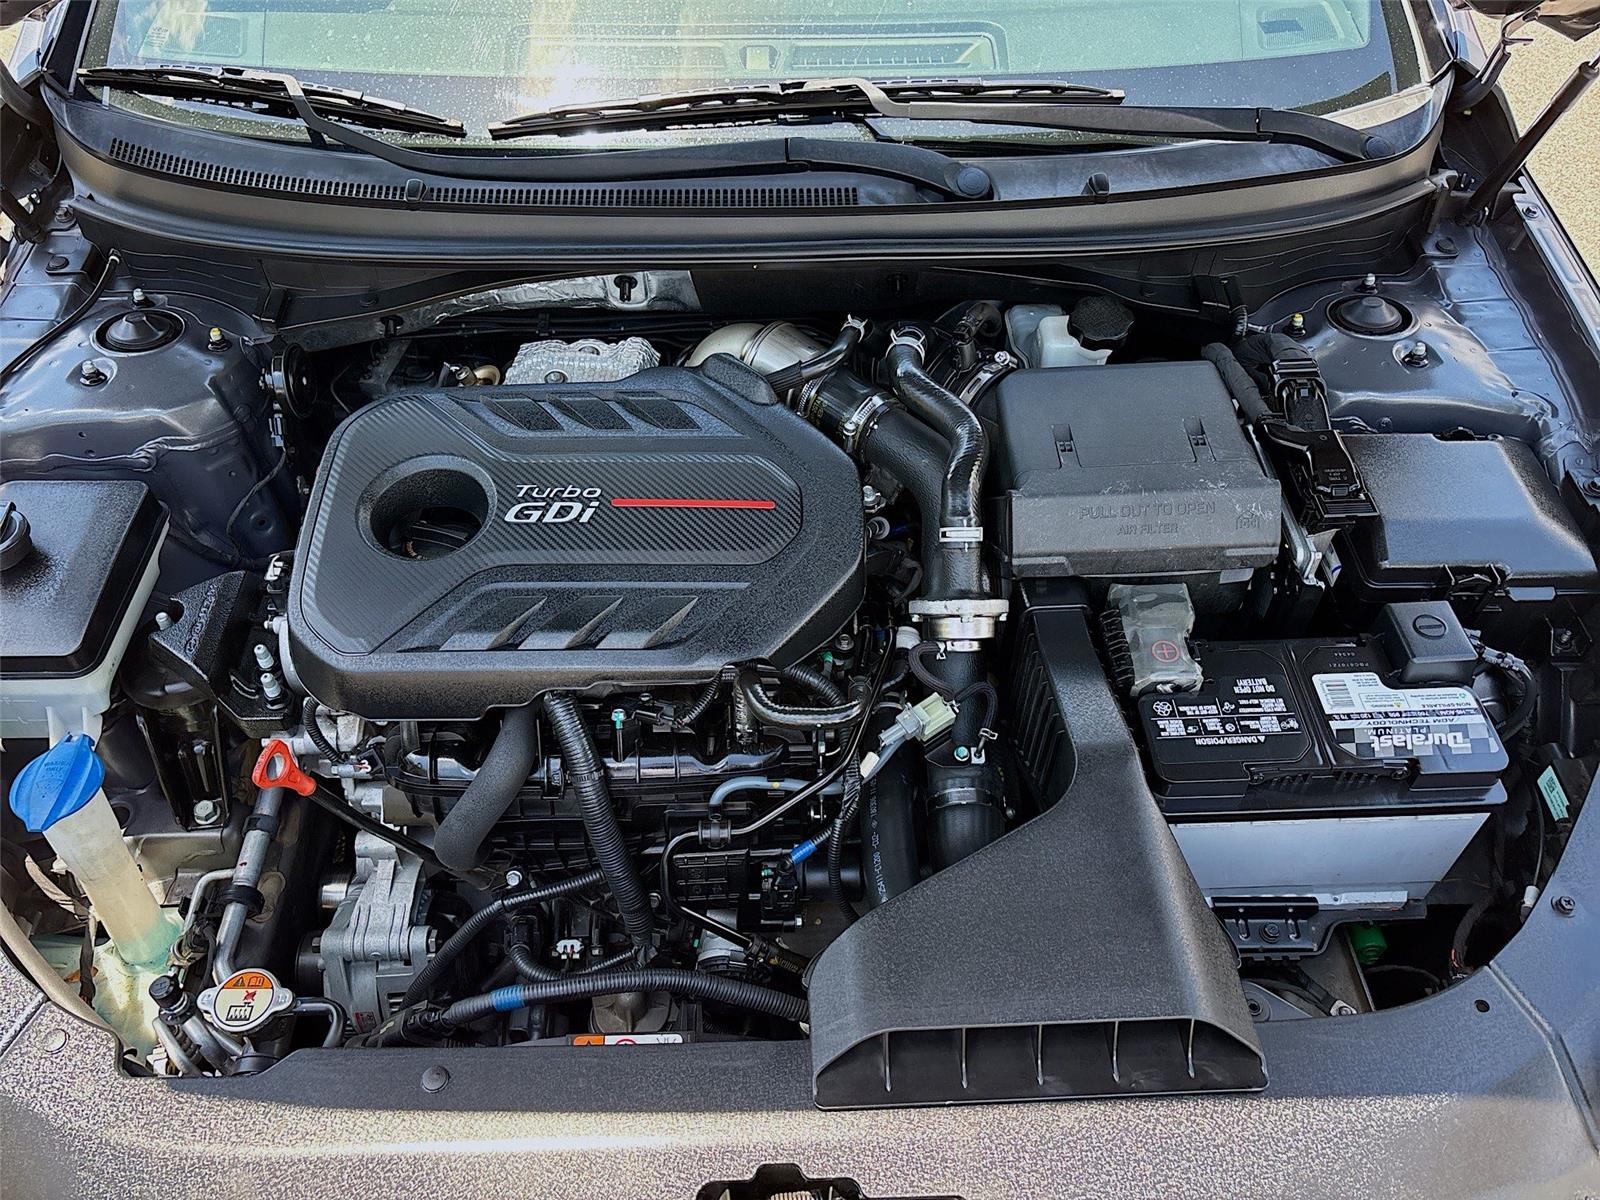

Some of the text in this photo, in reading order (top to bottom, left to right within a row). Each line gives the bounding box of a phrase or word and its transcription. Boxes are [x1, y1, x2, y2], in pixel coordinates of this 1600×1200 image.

[516, 484, 602, 498] Turbo
[504, 501, 600, 523] GDi
[1079, 501, 1216, 519] PULL OUT TO OPEN
[1116, 522, 1179, 536] AIR FILTER
[1233, 684, 1275, 694] DO NOT OPEN
[1236, 678, 1268, 686] BATTERY!
[1367, 718, 1429, 726] TECHNOLOGY
[1195, 736, 1258, 745] DANGER/POISON
[1370, 732, 1471, 752] Duralast
